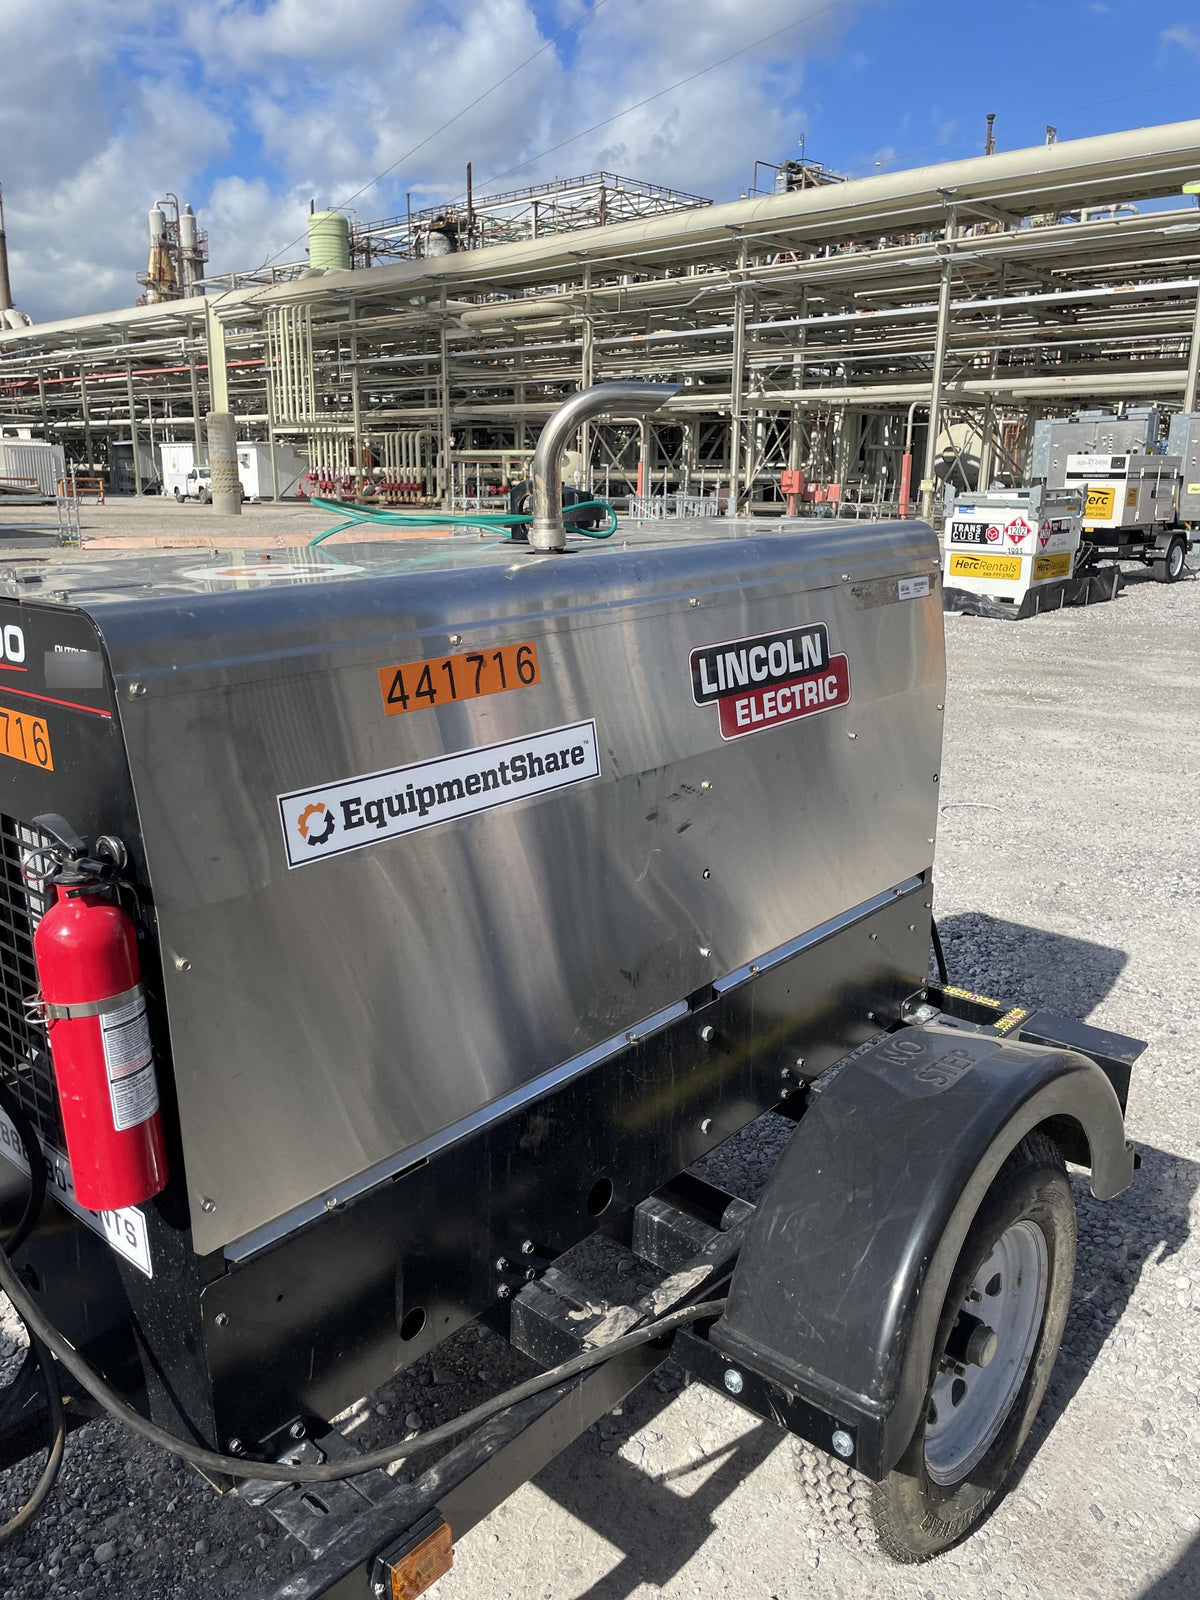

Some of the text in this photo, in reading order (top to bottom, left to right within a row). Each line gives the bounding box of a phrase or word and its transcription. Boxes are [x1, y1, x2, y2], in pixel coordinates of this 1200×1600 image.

[1087, 495, 1109, 505] erc
[952, 531, 981, 540] CUBE
[953, 523, 981, 533] TRANS
[1009, 527, 1026, 536] 1202
[955, 559, 1017, 573] HercRentals
[699, 633, 823, 695] LINCOLN
[387, 646, 536, 710] 441716
[735, 675, 839, 727] ELECTRIC
[339, 744, 585, 830] EquipmentShare
[876, 1040, 926, 1066] NO
[915, 1048, 977, 1087] STEP
